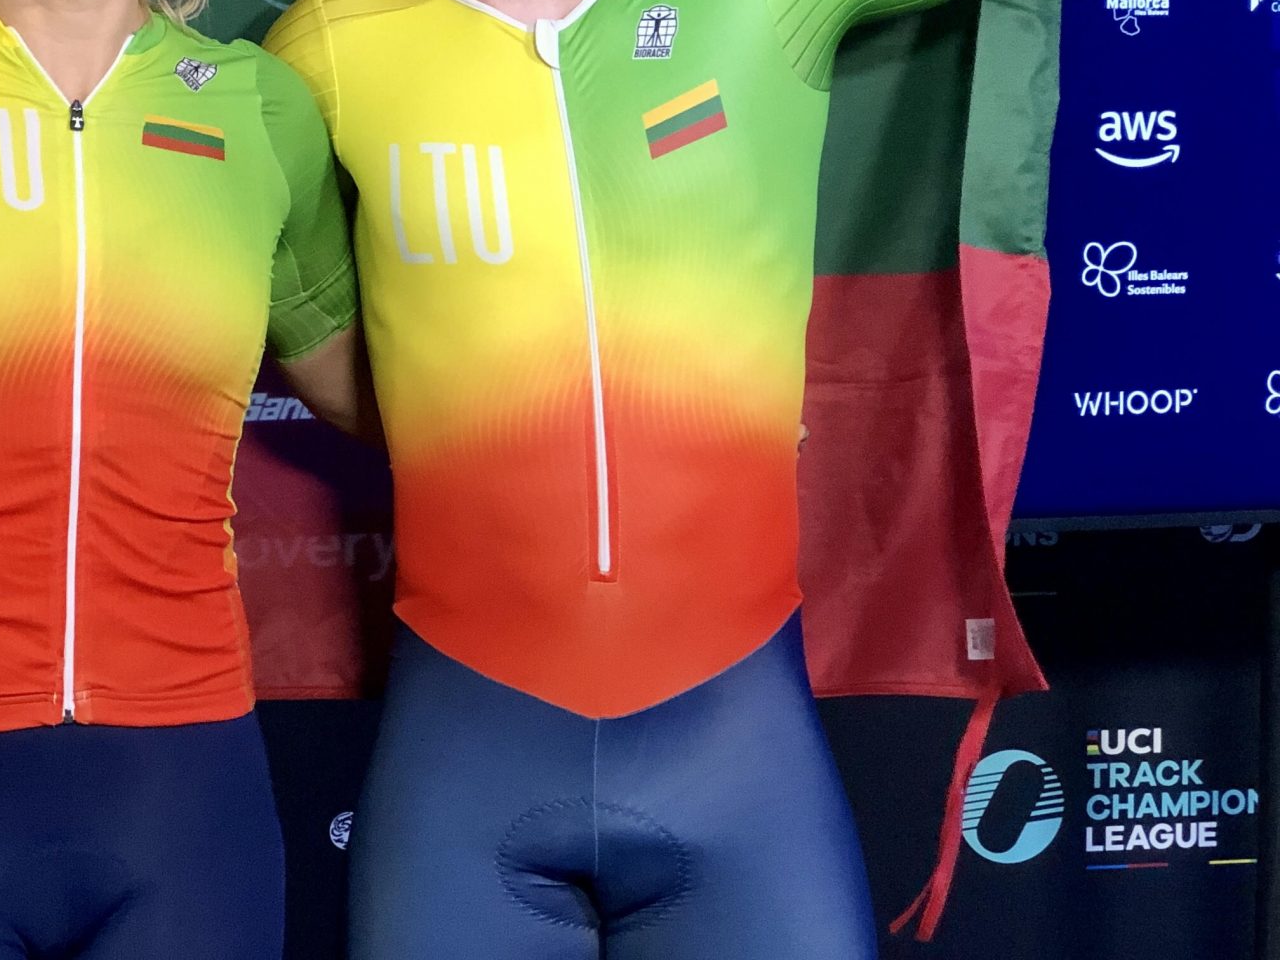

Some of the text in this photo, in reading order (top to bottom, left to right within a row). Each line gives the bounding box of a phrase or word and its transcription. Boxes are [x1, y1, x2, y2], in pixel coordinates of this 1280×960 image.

[633, 48, 671, 58] BIORACER
[1098, 110, 1178, 142] aws
[388, 141, 515, 265] LTU
[1128, 269, 1189, 281] Illes Balears
[1127, 283, 1187, 296] Sostenibles
[1074, 389, 1193, 417] WHOOP
[1100, 727, 1162, 755] UCI
[1087, 759, 1203, 788] TRACK
[1086, 821, 1218, 852] LEAGUE
